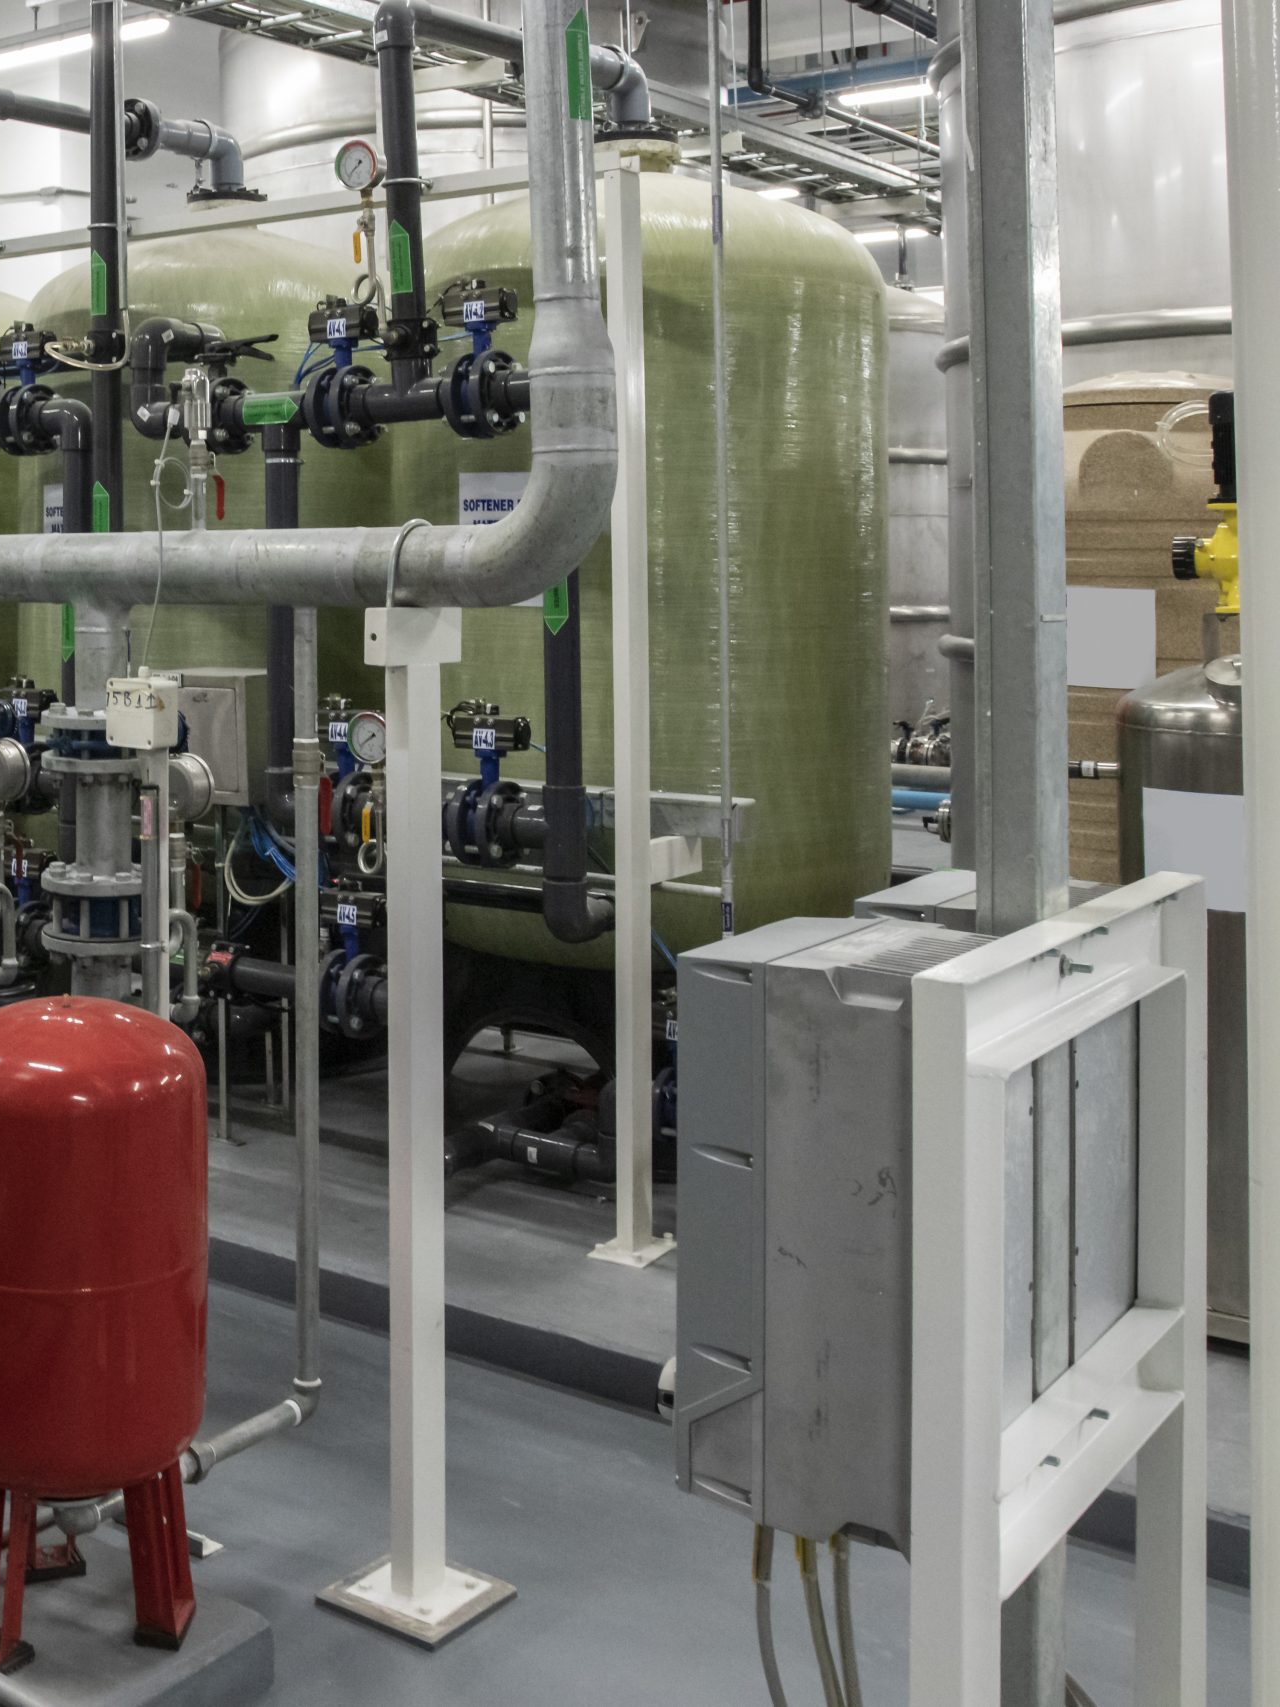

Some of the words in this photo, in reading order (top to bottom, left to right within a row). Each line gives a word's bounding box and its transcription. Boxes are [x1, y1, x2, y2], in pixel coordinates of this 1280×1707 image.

[464, 302, 484, 321] AV-4.2
[328, 319, 346, 337] AV-4.1
[46, 507, 64, 518] SOFTE
[463, 499, 514, 512] SOFTENER
[474, 730, 494, 748] AV-4.3
